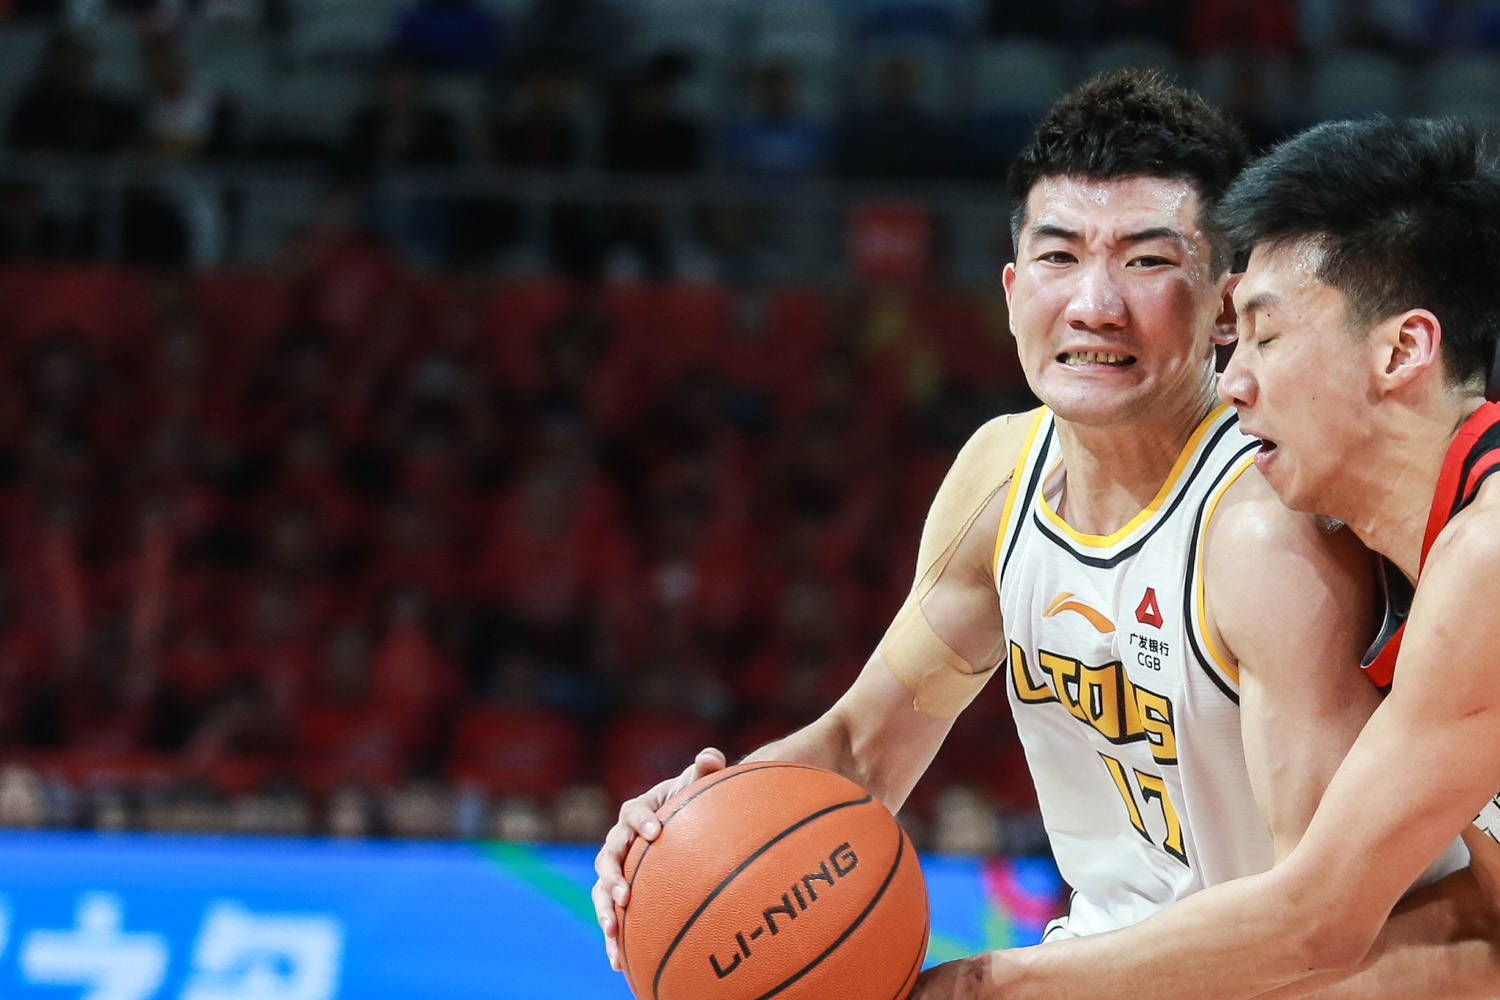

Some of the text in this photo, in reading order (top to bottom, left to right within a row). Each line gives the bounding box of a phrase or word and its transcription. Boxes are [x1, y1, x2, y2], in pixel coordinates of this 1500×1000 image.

[1129, 633, 1169, 656] 广发银行
[1137, 652, 1161, 671] CGB
[1098, 751, 1190, 868] 17
[709, 842, 859, 979] LI-NING
